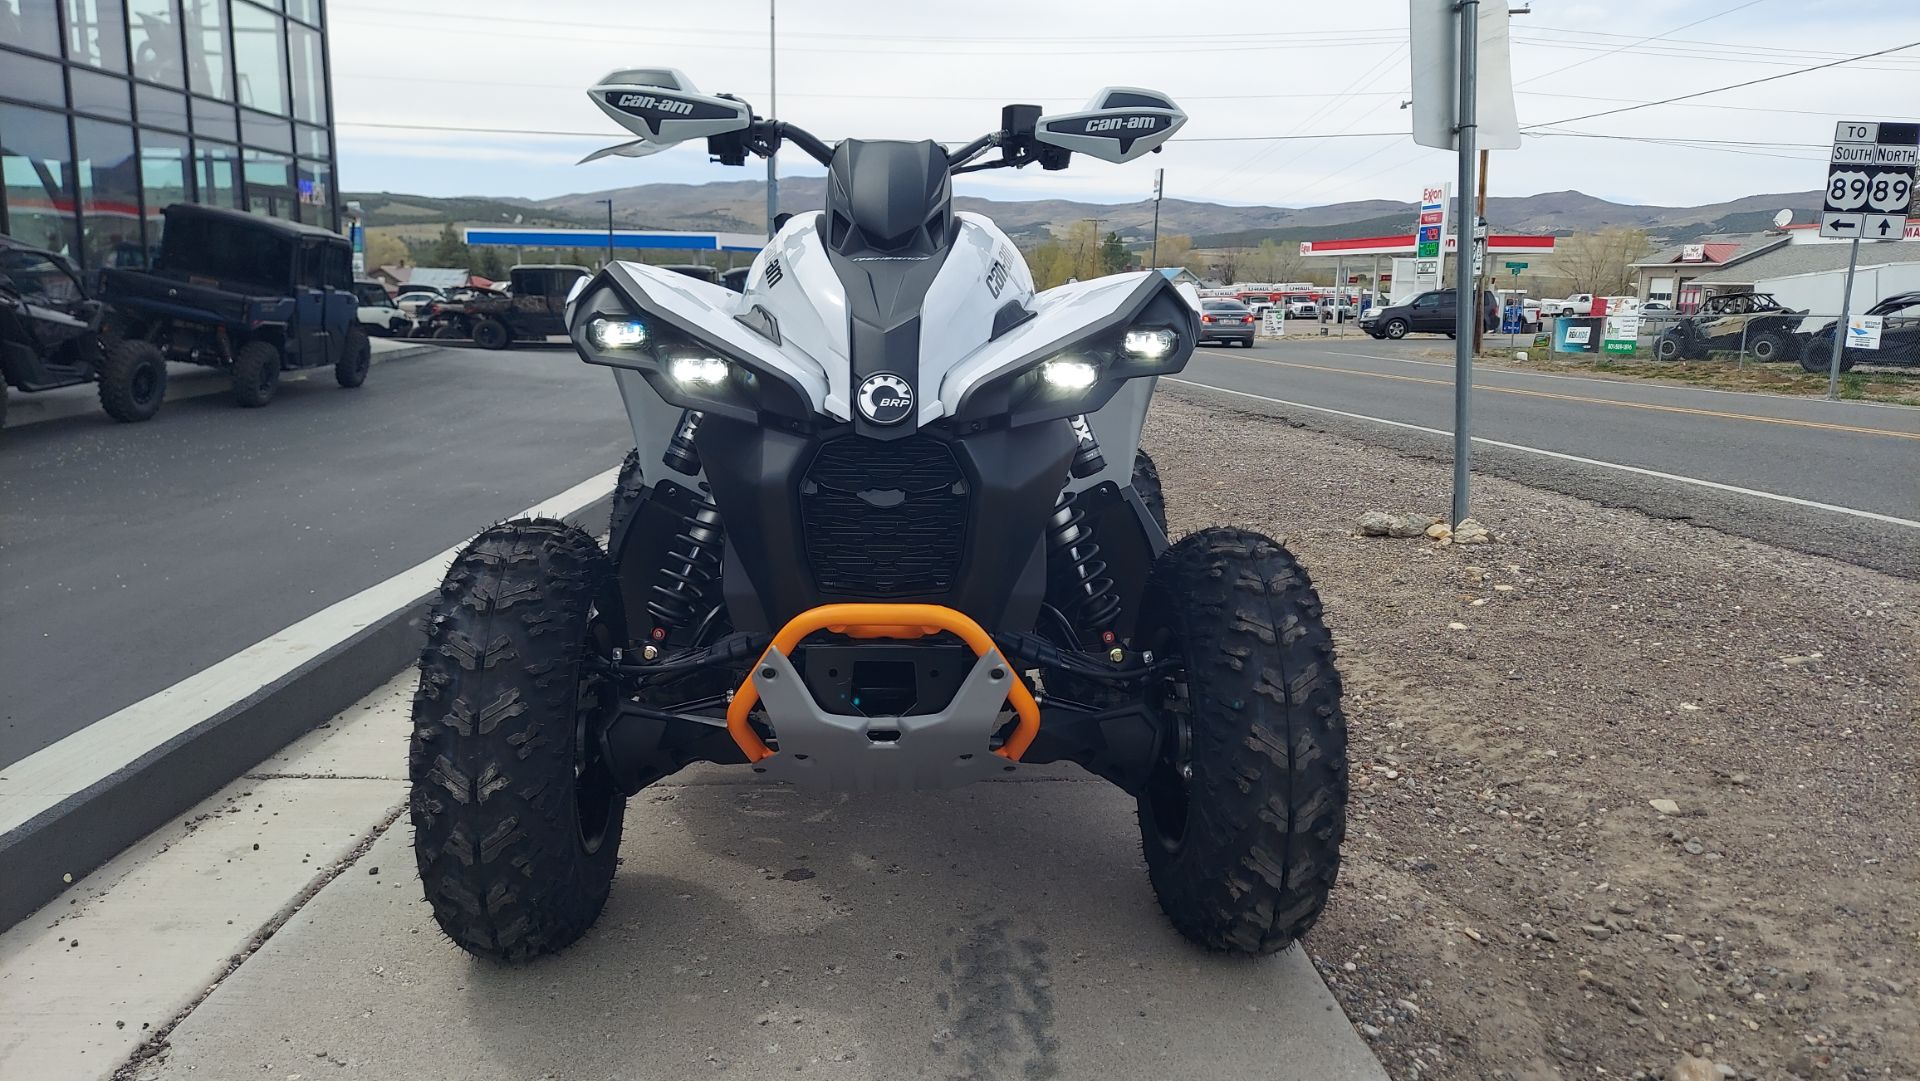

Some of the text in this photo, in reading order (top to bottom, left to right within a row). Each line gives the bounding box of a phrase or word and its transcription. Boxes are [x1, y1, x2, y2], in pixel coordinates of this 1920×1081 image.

[618, 93, 694, 115] can-am
[1086, 116, 1156, 132] can-am
[1848, 126, 1867, 138] TO
[1835, 146, 1872, 161] SOUTH
[1877, 148, 1916, 163] NORTH
[1423, 188, 1442, 203] Exxon
[1831, 178, 1866, 200] 89
[1873, 180, 1909, 202] 89
[985, 242, 1015, 300] can-am
[880, 398, 911, 407] BRP
